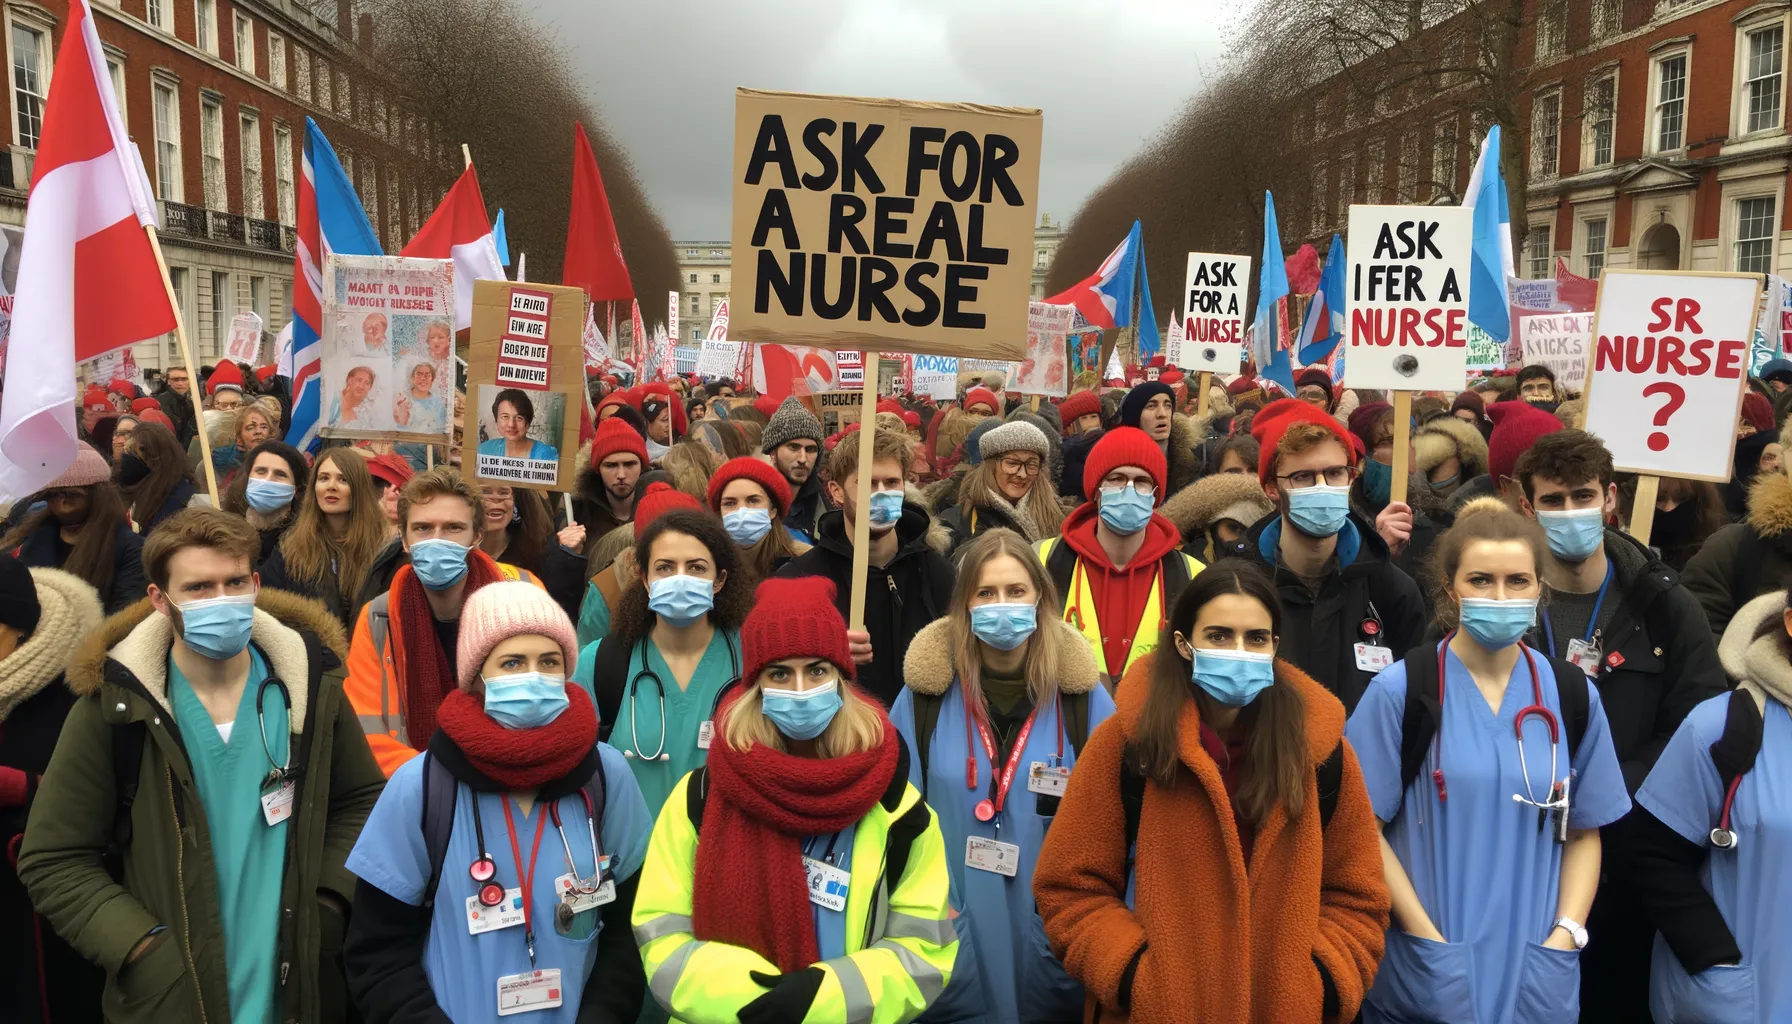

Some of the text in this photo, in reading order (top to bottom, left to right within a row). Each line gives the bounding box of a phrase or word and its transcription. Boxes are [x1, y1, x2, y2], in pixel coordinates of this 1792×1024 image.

[744, 114, 1025, 207] ASK FOR
[750, 188, 1009, 265] A REAL
[1373, 221, 1443, 260] ASK
[754, 249, 989, 330] NURSE
[1193, 261, 1238, 287] ASK
[1438, 267, 1462, 302] A
[1189, 289, 1239, 316] FOR A
[1647, 297, 1704, 335] SR
[1185, 316, 1242, 344] NURSE
[1351, 307, 1467, 348] NURSE
[1595, 335, 1747, 380] NURSE
[1642, 381, 1686, 452] ?
